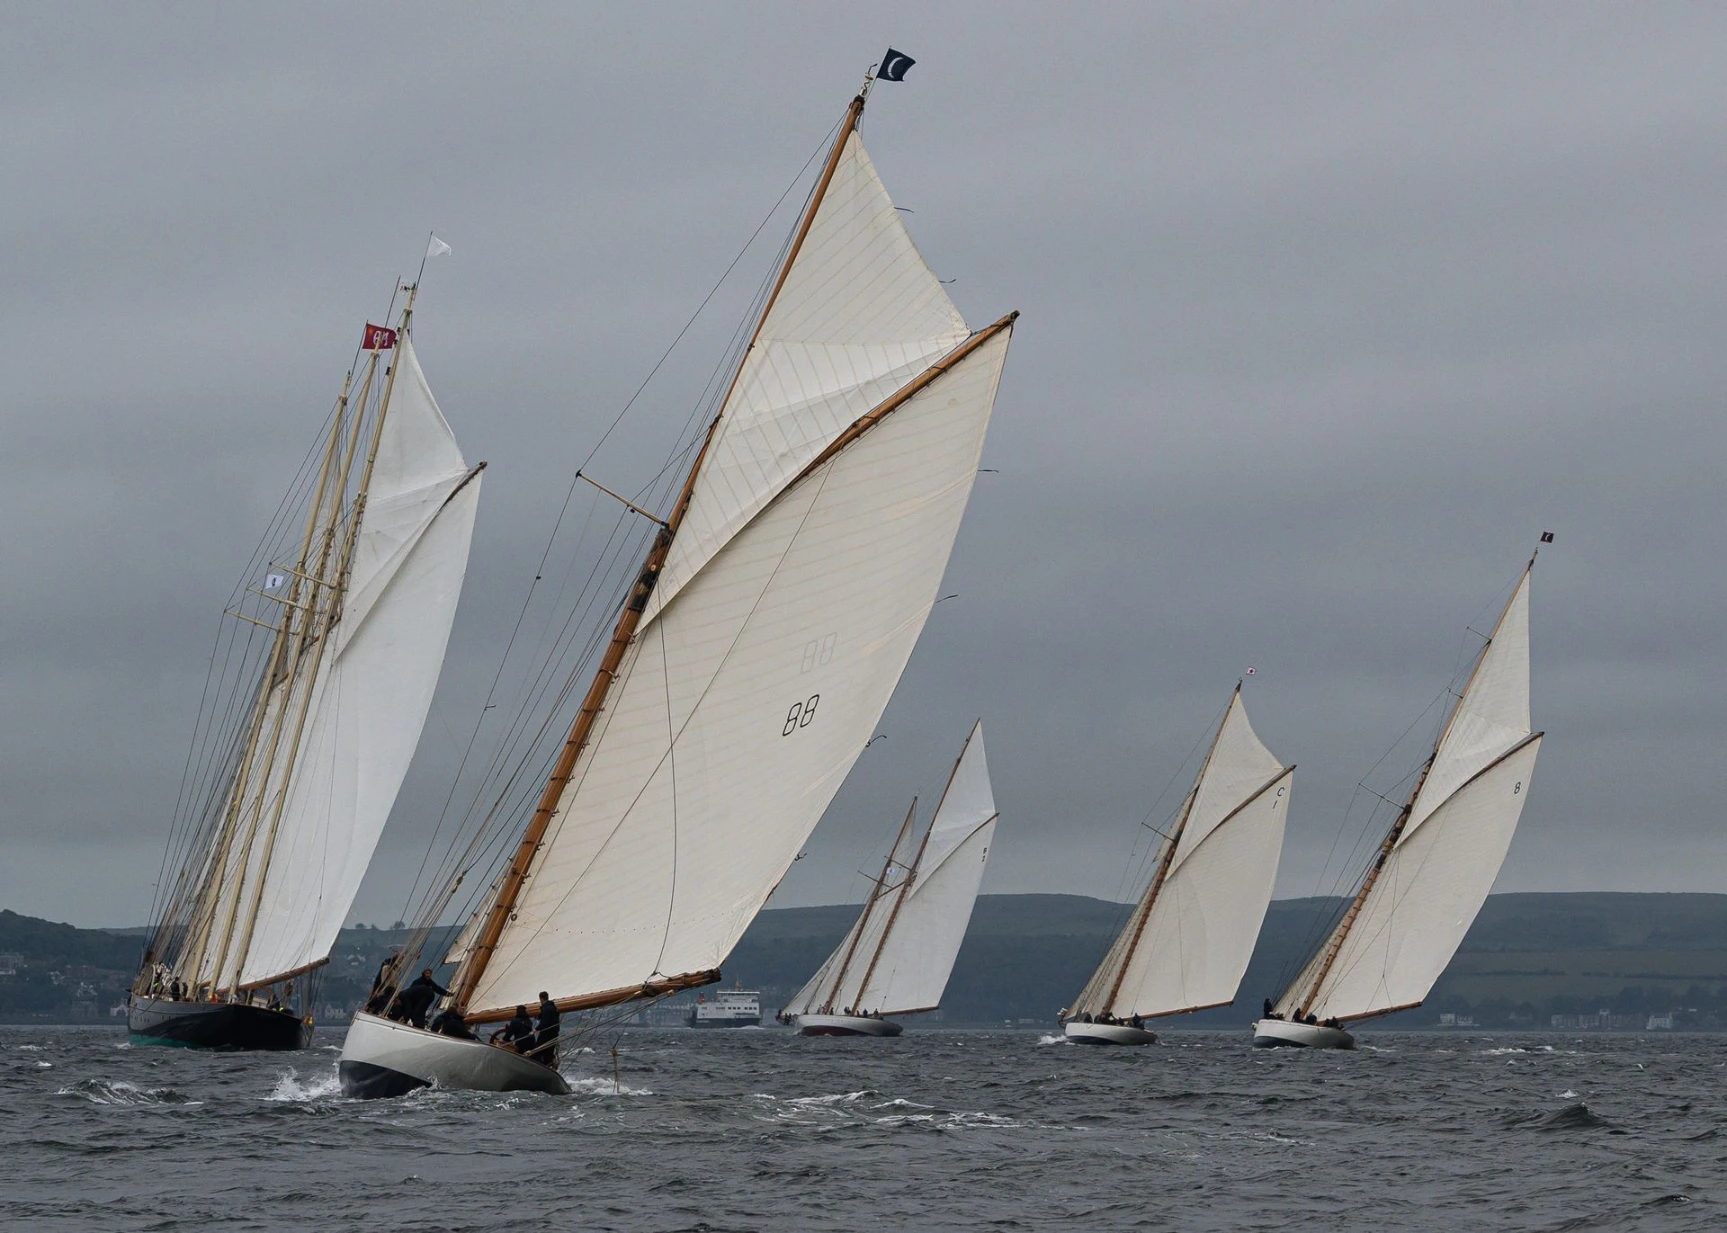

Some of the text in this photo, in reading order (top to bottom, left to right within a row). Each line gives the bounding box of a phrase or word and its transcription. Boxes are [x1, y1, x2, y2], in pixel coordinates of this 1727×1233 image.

[782, 694, 820, 737] 88
[1277, 786, 1285, 797] C
[1514, 781, 1521, 794] 8
